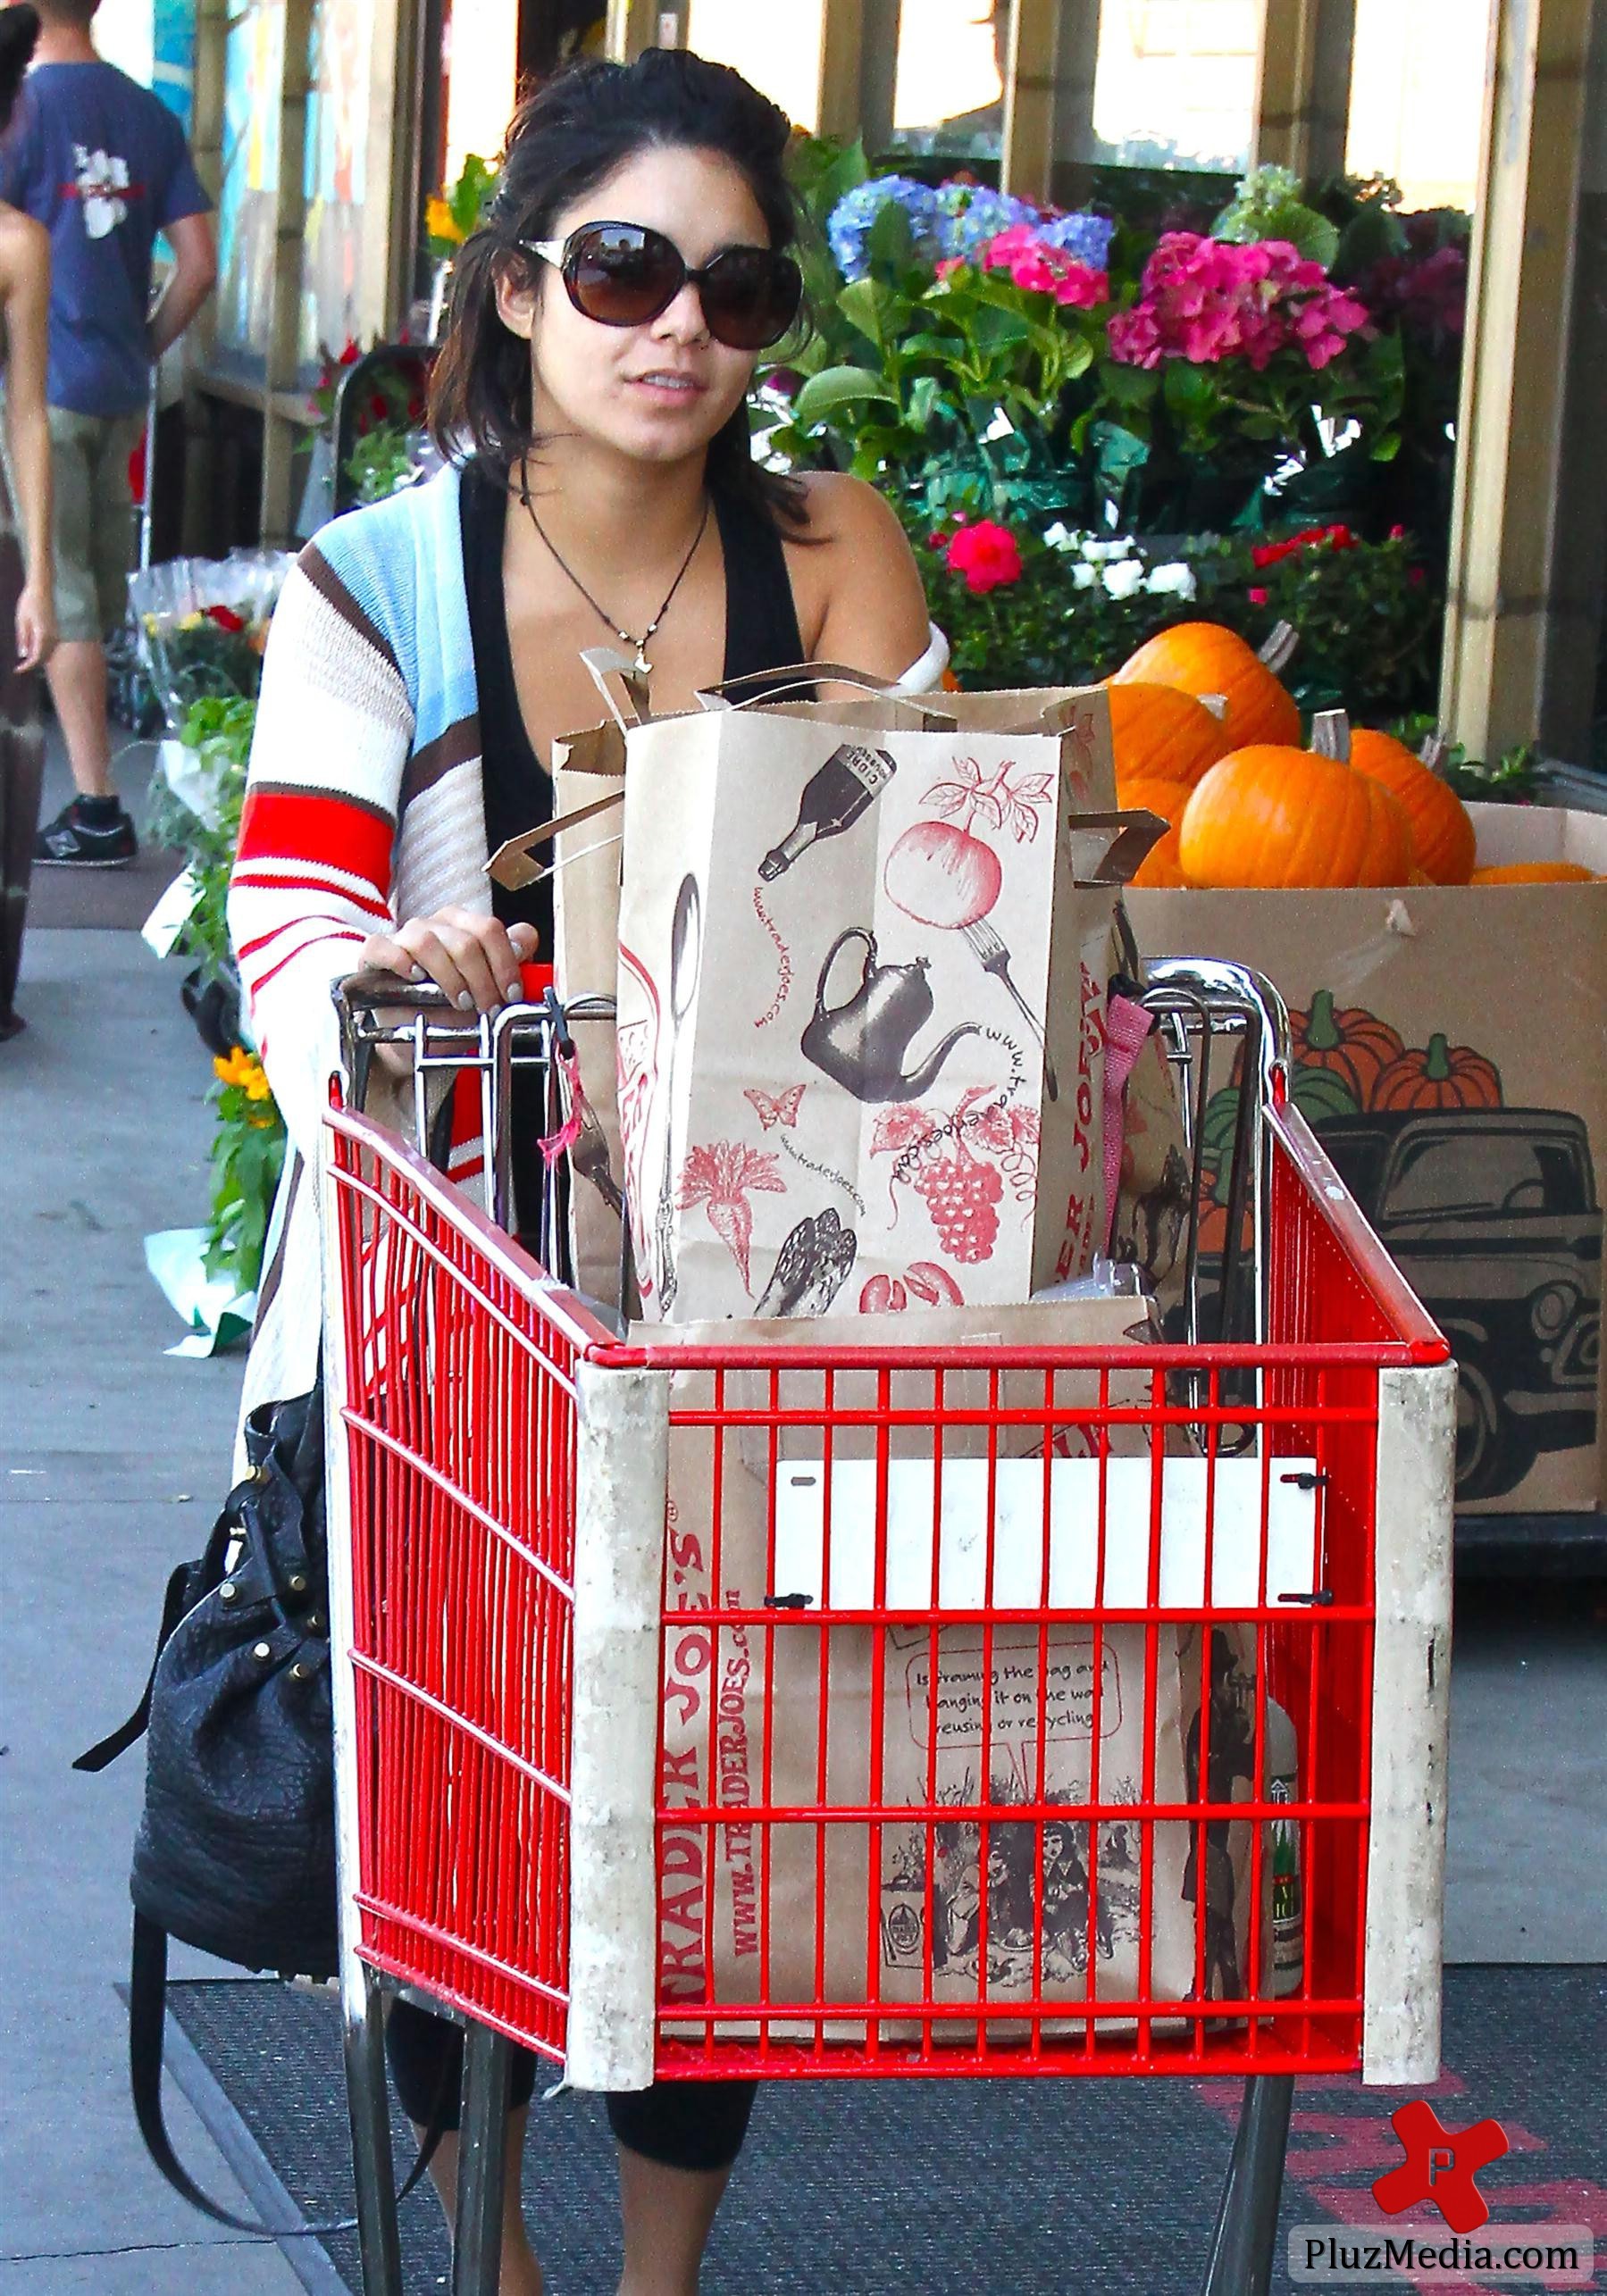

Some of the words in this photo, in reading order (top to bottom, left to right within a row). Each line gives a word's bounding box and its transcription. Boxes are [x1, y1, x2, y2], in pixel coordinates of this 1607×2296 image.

[846, 750, 879, 785] CIDRE
[916, 1673, 930, 1686] Is
[1003, 1665, 1034, 1680] the
[926, 1692, 991, 1713] angin
[994, 1691, 1009, 1705] it
[1013, 1692, 1032, 1705] on
[1037, 1688, 1066, 1701] he
[936, 1718, 991, 1734] reusin
[997, 1718, 1013, 1730] or
[1018, 1709, 1093, 1730] reycling
